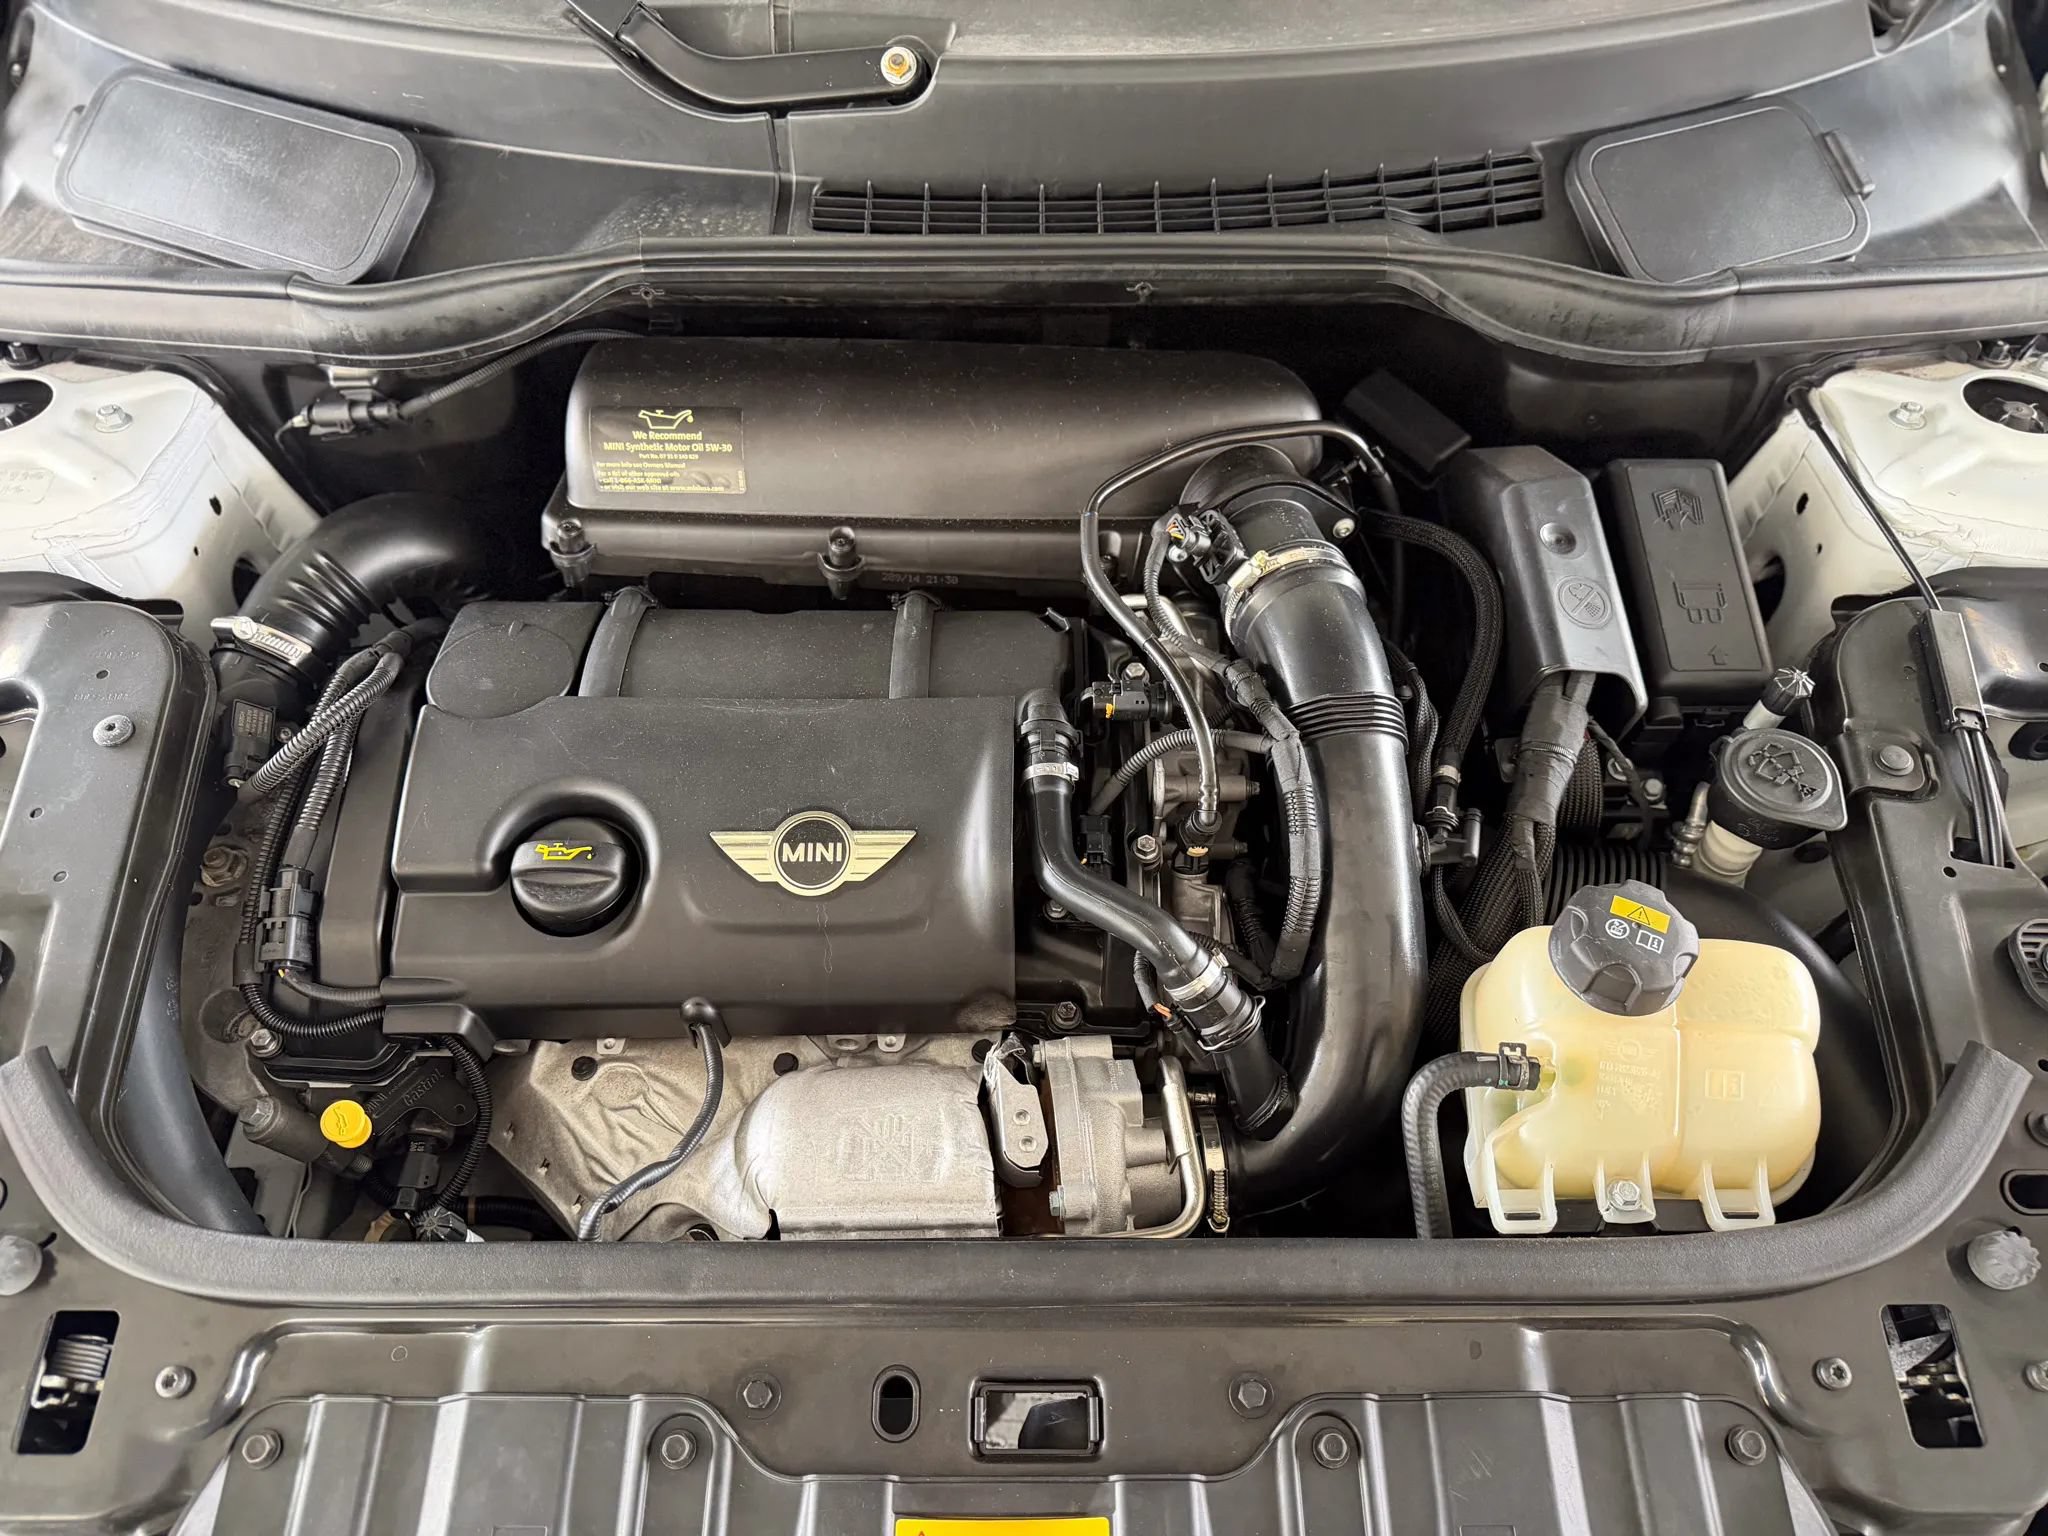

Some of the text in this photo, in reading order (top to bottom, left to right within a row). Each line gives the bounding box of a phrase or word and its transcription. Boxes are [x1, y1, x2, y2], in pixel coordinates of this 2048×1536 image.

[632, 430, 702, 441] We Recommend
[604, 442, 732, 453] MINI Synthetic Motor Oil 5W-30
[782, 842, 843, 863] MINI
